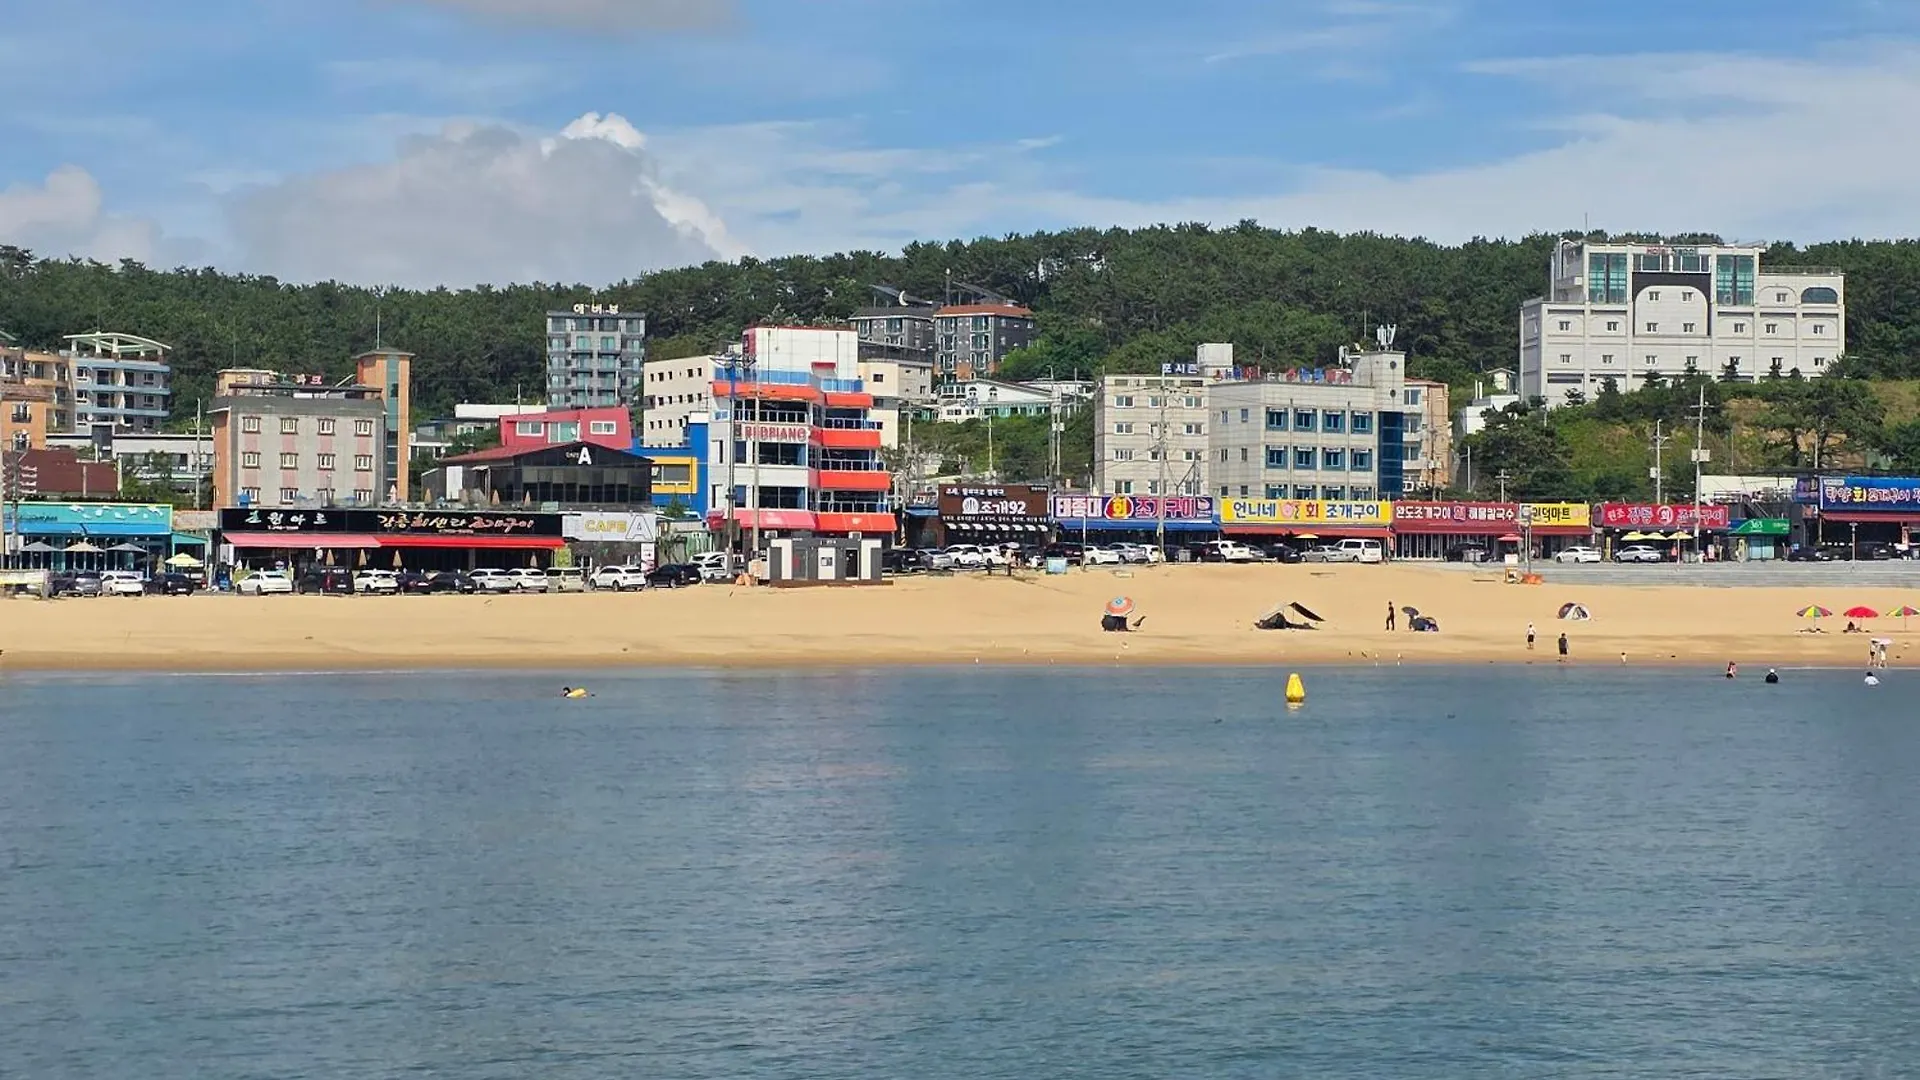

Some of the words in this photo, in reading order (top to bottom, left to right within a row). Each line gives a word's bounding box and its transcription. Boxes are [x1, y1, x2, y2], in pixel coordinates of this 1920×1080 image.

[577, 446, 592, 465] A
[979, 500, 1026, 515] 조개92
[1055, 498, 1102, 518] 태종대
[1112, 497, 1128, 518] 회
[1135, 498, 1197, 519] 조개구이
[1233, 501, 1276, 519] 언니네
[1305, 502, 1319, 518] 회
[1325, 503, 1379, 519] 조개구이
[1395, 505, 1451, 520] 완도조개구이
[1468, 506, 1515, 521] 해물칼국수
[584, 519, 628, 533] CAFE
[625, 514, 654, 540] A
